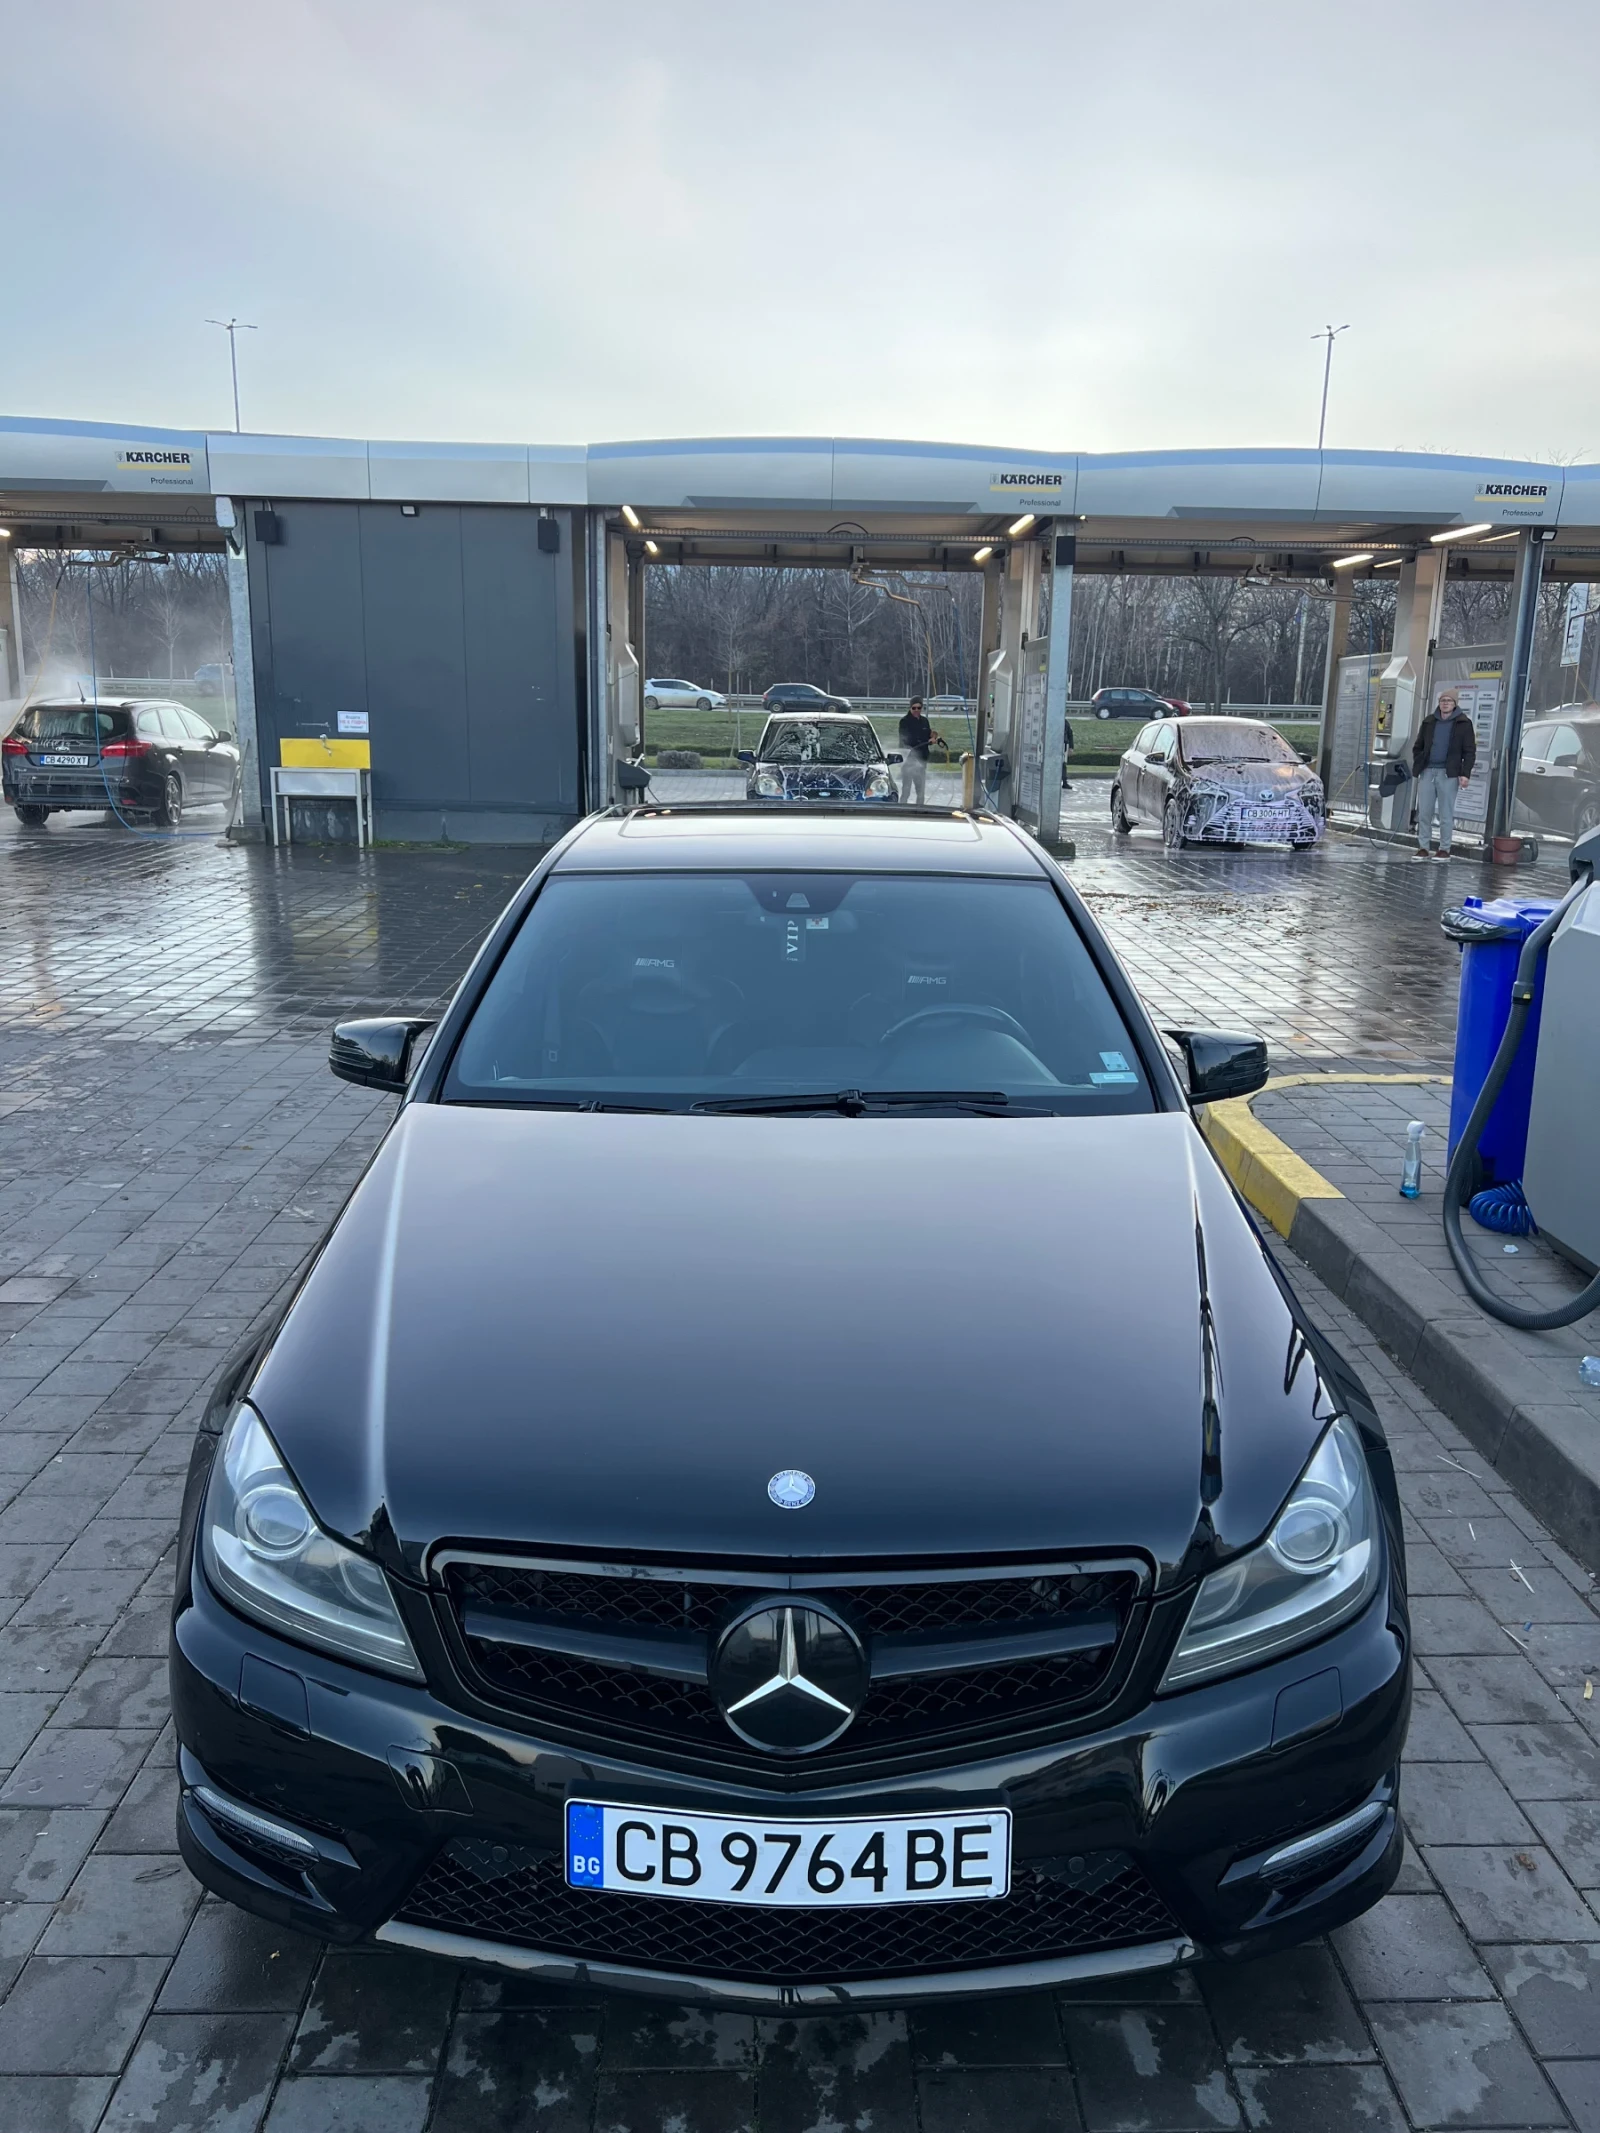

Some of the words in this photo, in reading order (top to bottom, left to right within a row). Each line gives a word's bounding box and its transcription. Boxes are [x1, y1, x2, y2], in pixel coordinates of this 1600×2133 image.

[126, 452, 190, 463] KÄRCHER
[150, 477, 193, 485] Professional
[1001, 474, 1062, 485] KÄRCHER
[1485, 484, 1547, 496] KÄRCHER
[1019, 499, 1061, 507] Professional
[1502, 509, 1543, 517] Professional
[787, 920, 799, 954] VIP
[616, 1820, 701, 1886] CB
[720, 1831, 888, 1894] 9764
[906, 1825, 993, 1890] BE
[573, 1856, 600, 1875] BG
